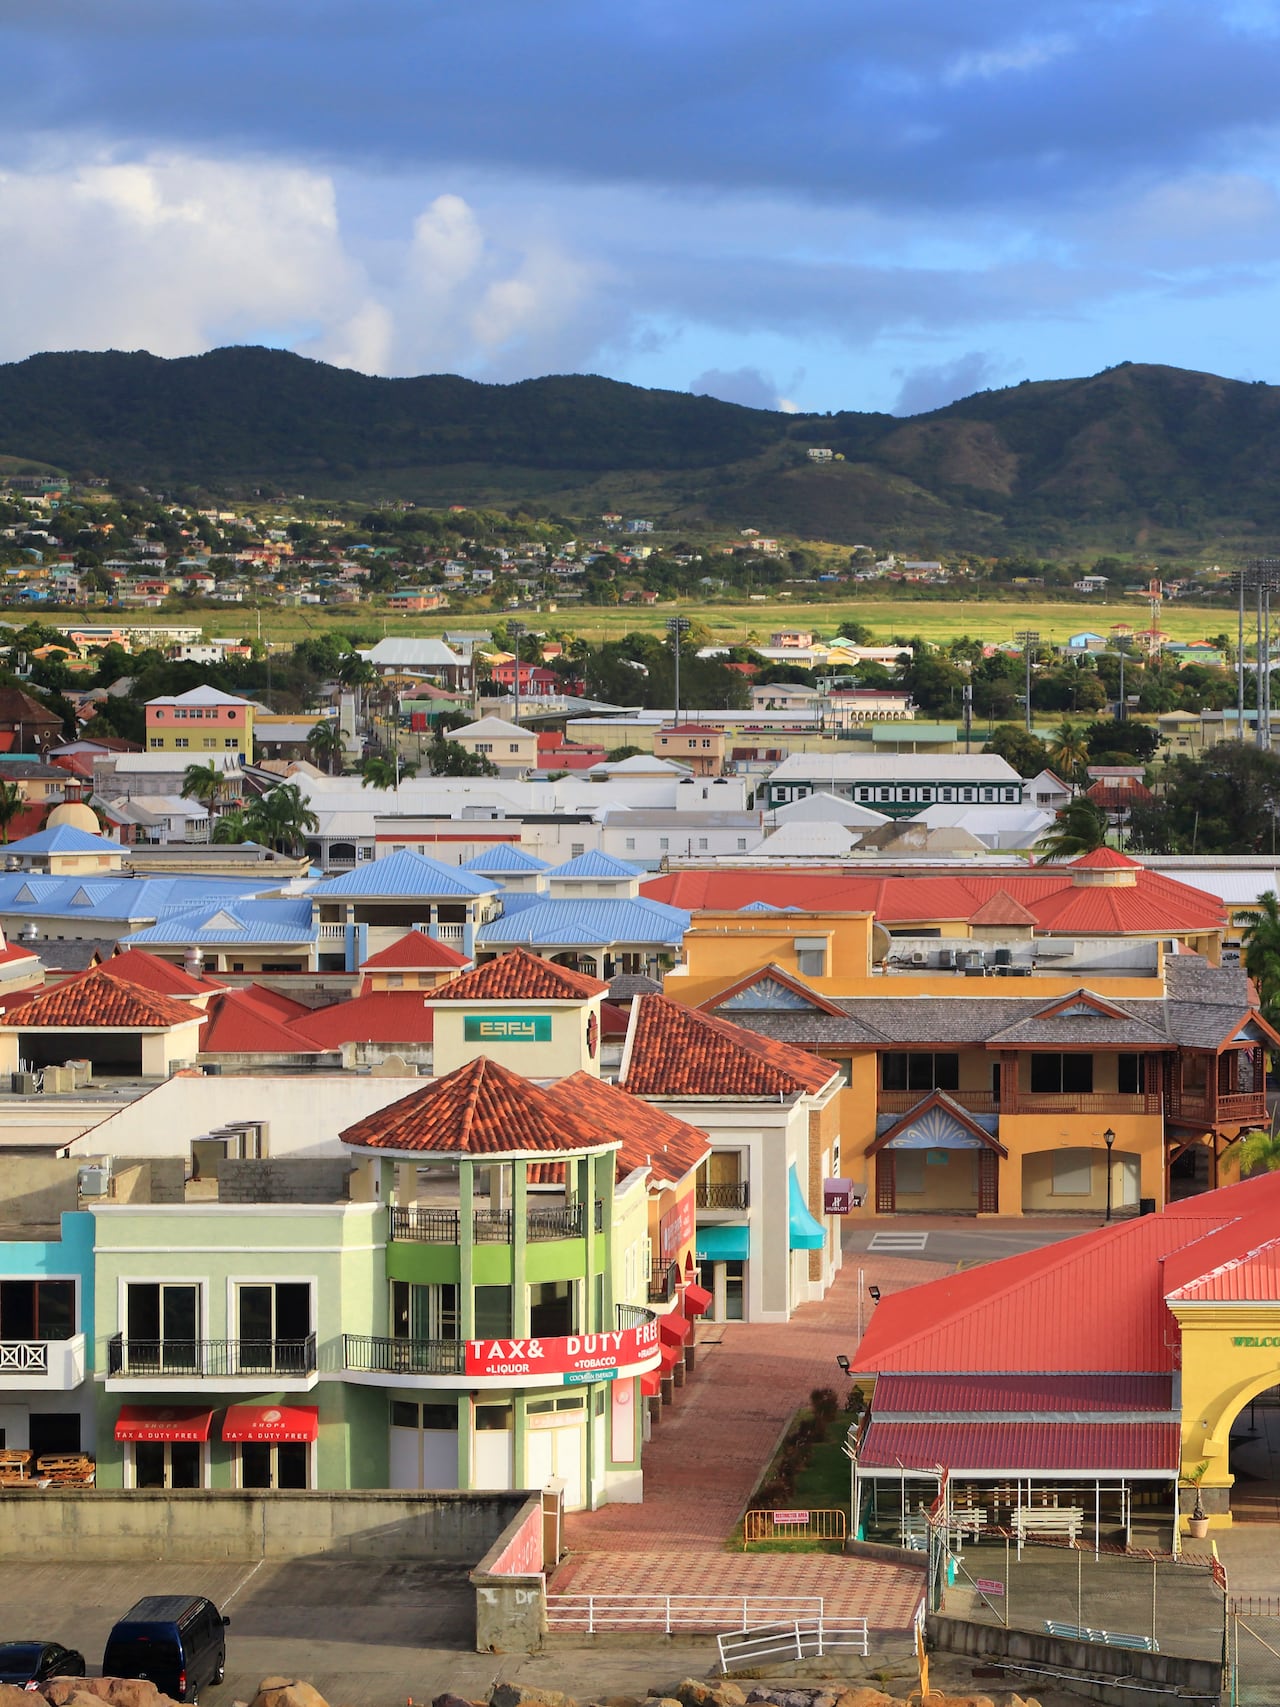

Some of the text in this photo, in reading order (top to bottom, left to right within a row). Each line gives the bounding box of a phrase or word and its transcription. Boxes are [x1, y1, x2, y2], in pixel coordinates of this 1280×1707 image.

[566, 1331, 624, 1356] DUTY
[635, 1320, 658, 1346] FREE
[116, 1431, 198, 1439] TAX & DUTY FREE
[257, 1432, 280, 1440] DUTY
[285, 1432, 308, 1440] FREE
